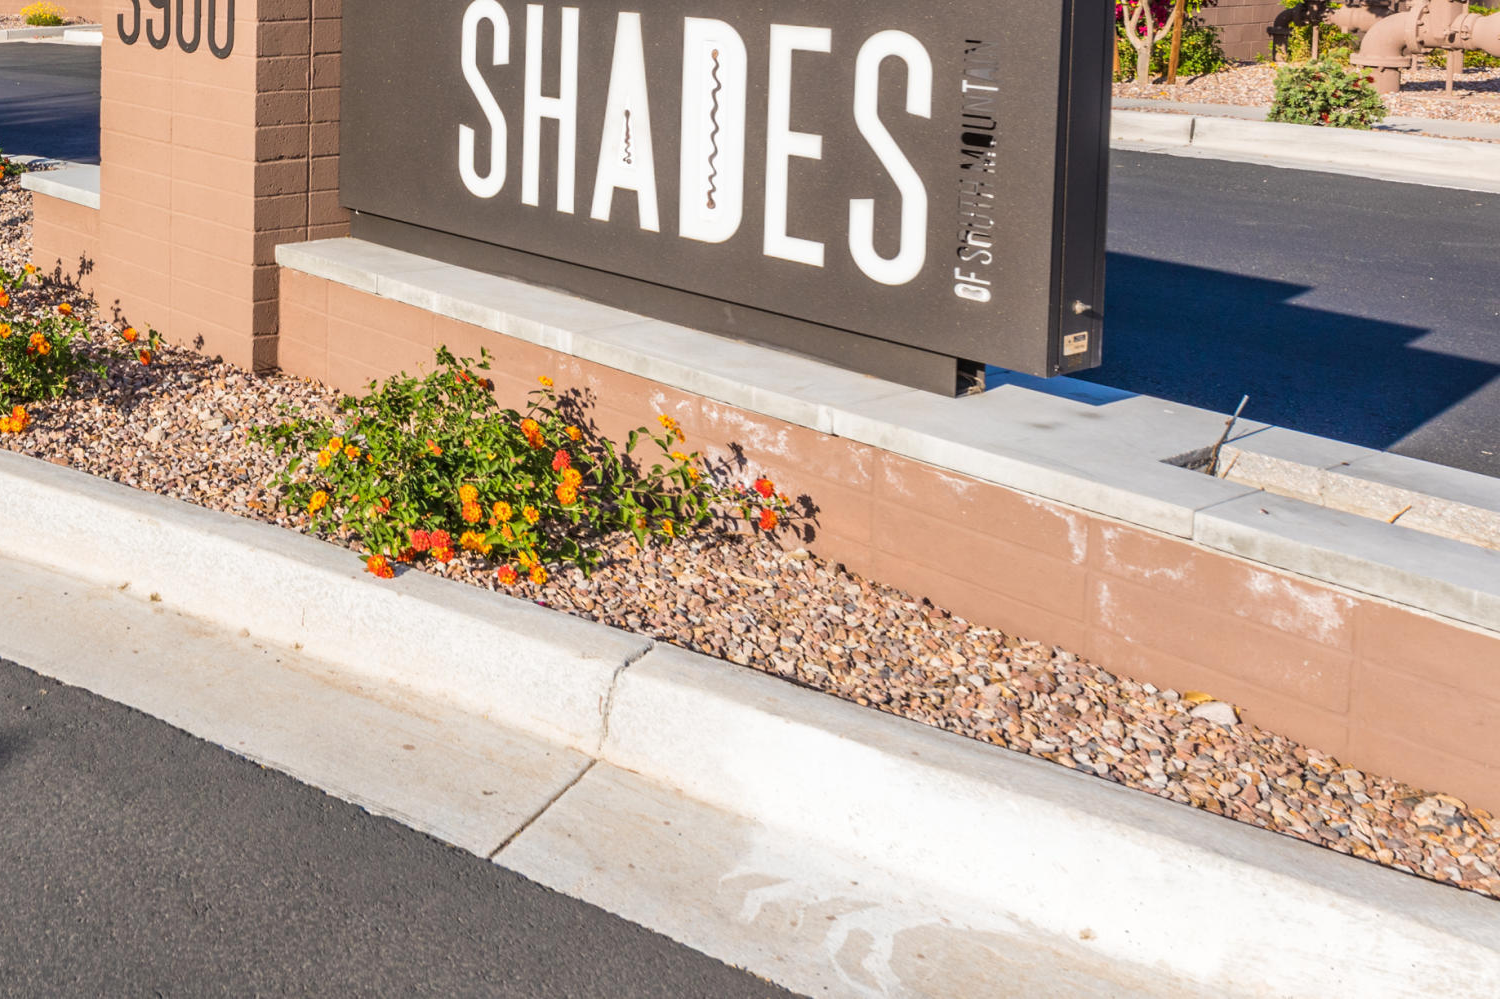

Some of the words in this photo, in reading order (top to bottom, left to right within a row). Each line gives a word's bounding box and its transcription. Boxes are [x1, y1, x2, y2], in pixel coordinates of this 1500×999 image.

[959, 39, 1000, 174] MOUNTAIN
[956, 179, 994, 265] SOUTH
[954, 267, 991, 303] OF
